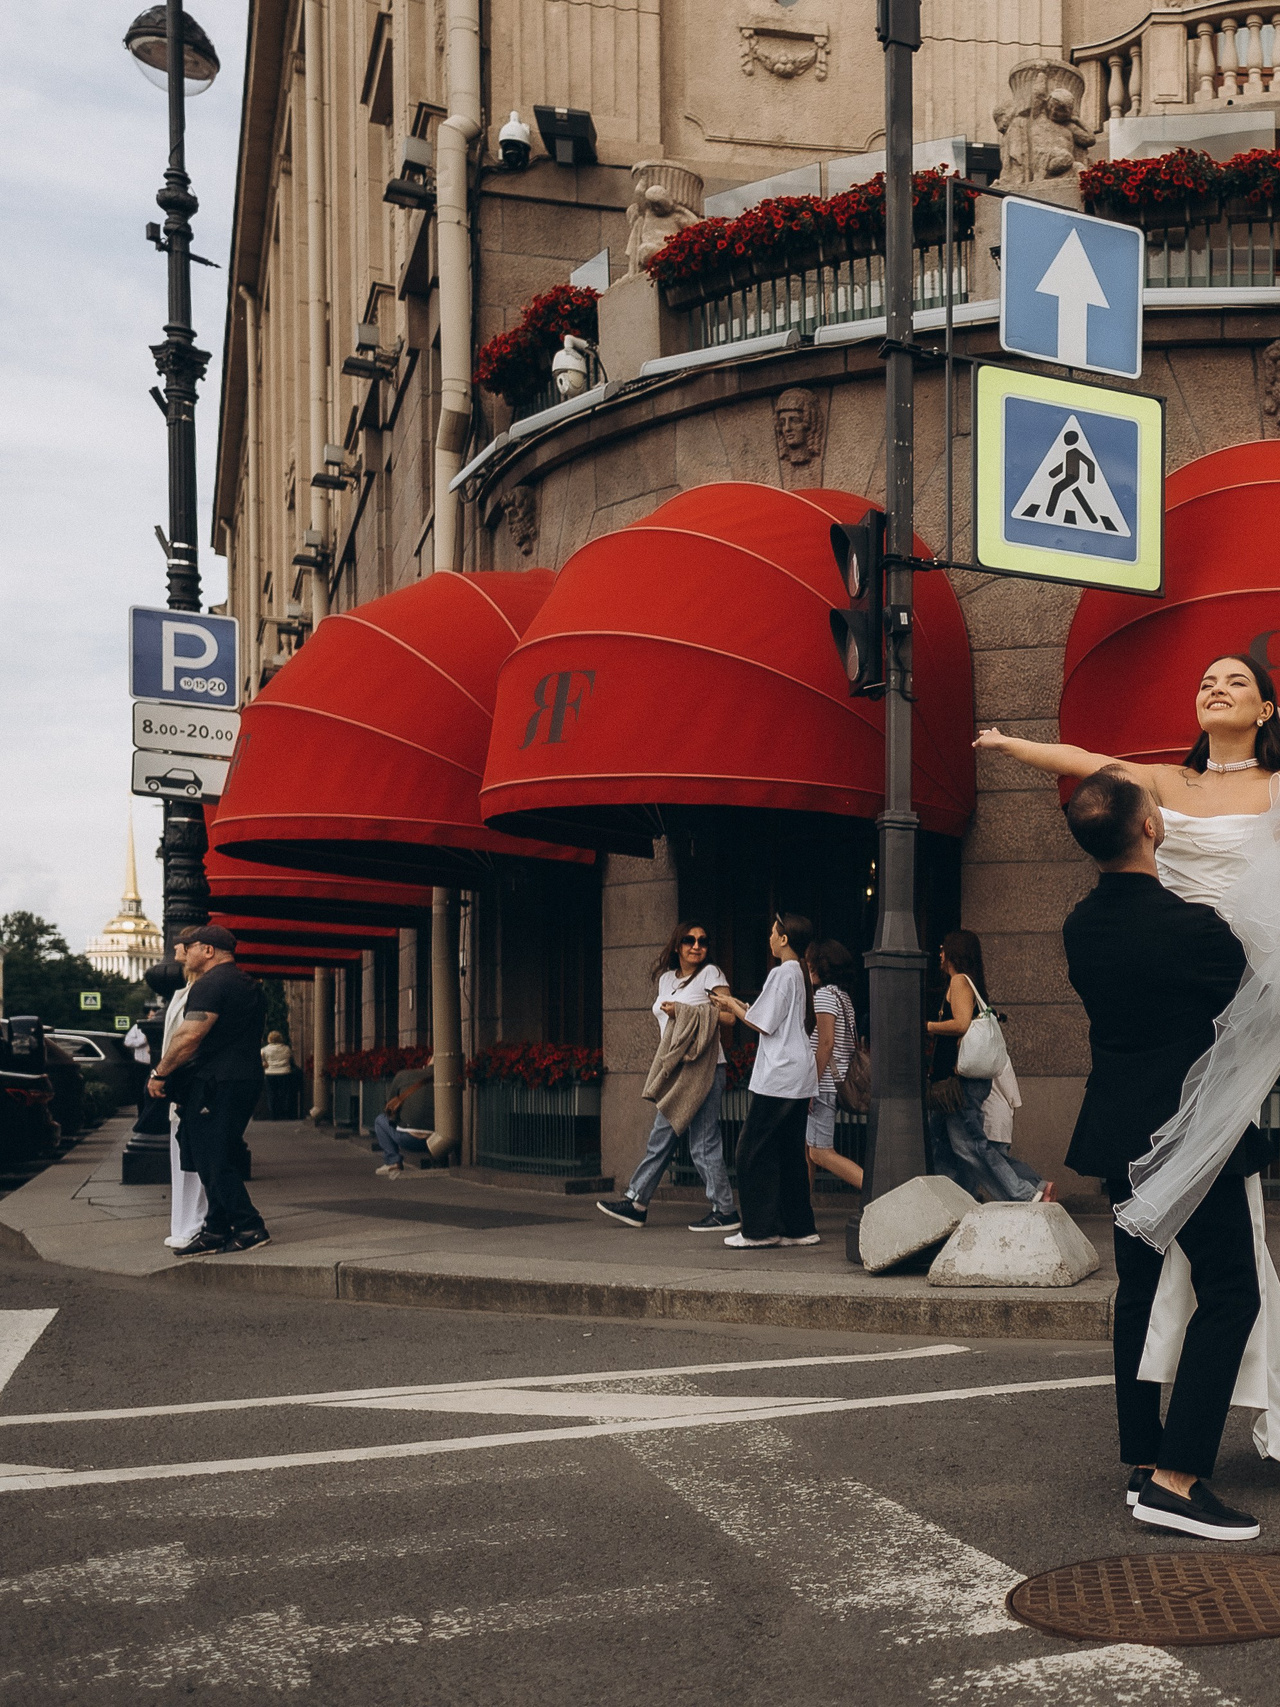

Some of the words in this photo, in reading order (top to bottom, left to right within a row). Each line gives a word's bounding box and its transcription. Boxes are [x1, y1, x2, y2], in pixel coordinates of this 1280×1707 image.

[162, 620, 219, 692] P
[183, 679, 193, 688] 10
[194, 680, 206, 690] 15
[208, 681, 226, 693] 20
[142, 719, 234, 742] 8.00-20.00
